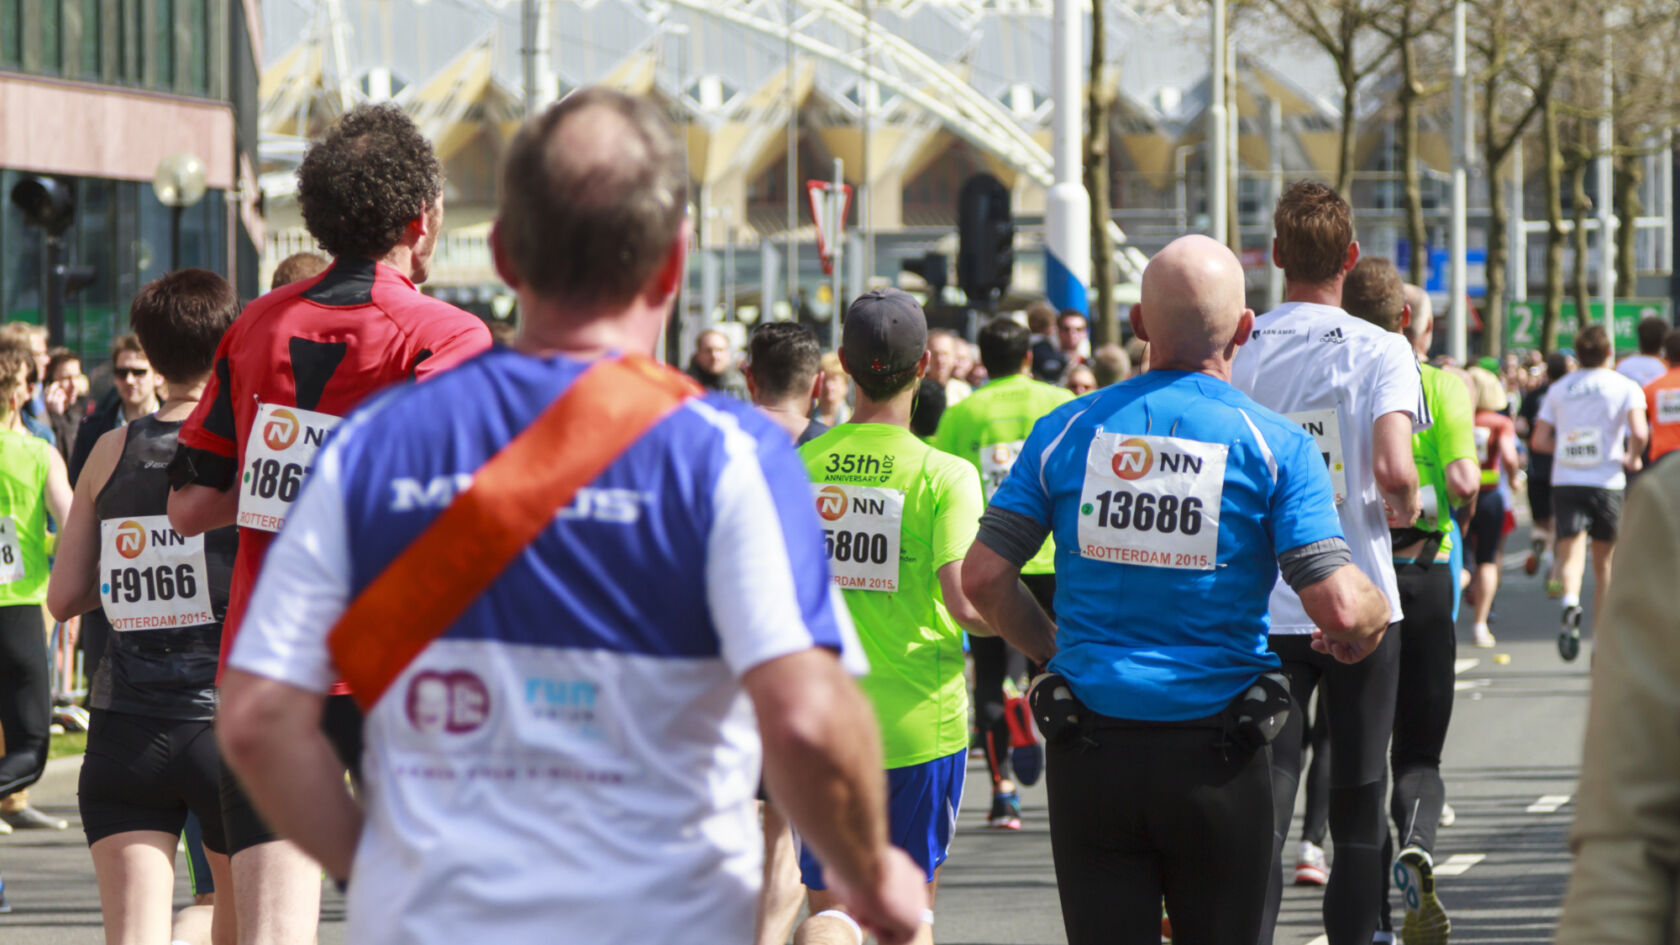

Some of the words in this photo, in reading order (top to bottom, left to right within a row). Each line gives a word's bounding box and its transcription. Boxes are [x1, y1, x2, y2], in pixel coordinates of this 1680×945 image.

[1512, 306, 1533, 343] 2
[825, 453, 880, 474] 35th
[1160, 452, 1202, 474] NN
[853, 497, 885, 515] NN
[1096, 490, 1203, 535] 13686
[1086, 544, 1171, 565] ROTTERDAM
[1175, 553, 1207, 566] 2015
[111, 564, 197, 603] F9166
[869, 578, 893, 589] 2015
[180, 612, 208, 625] 2015
